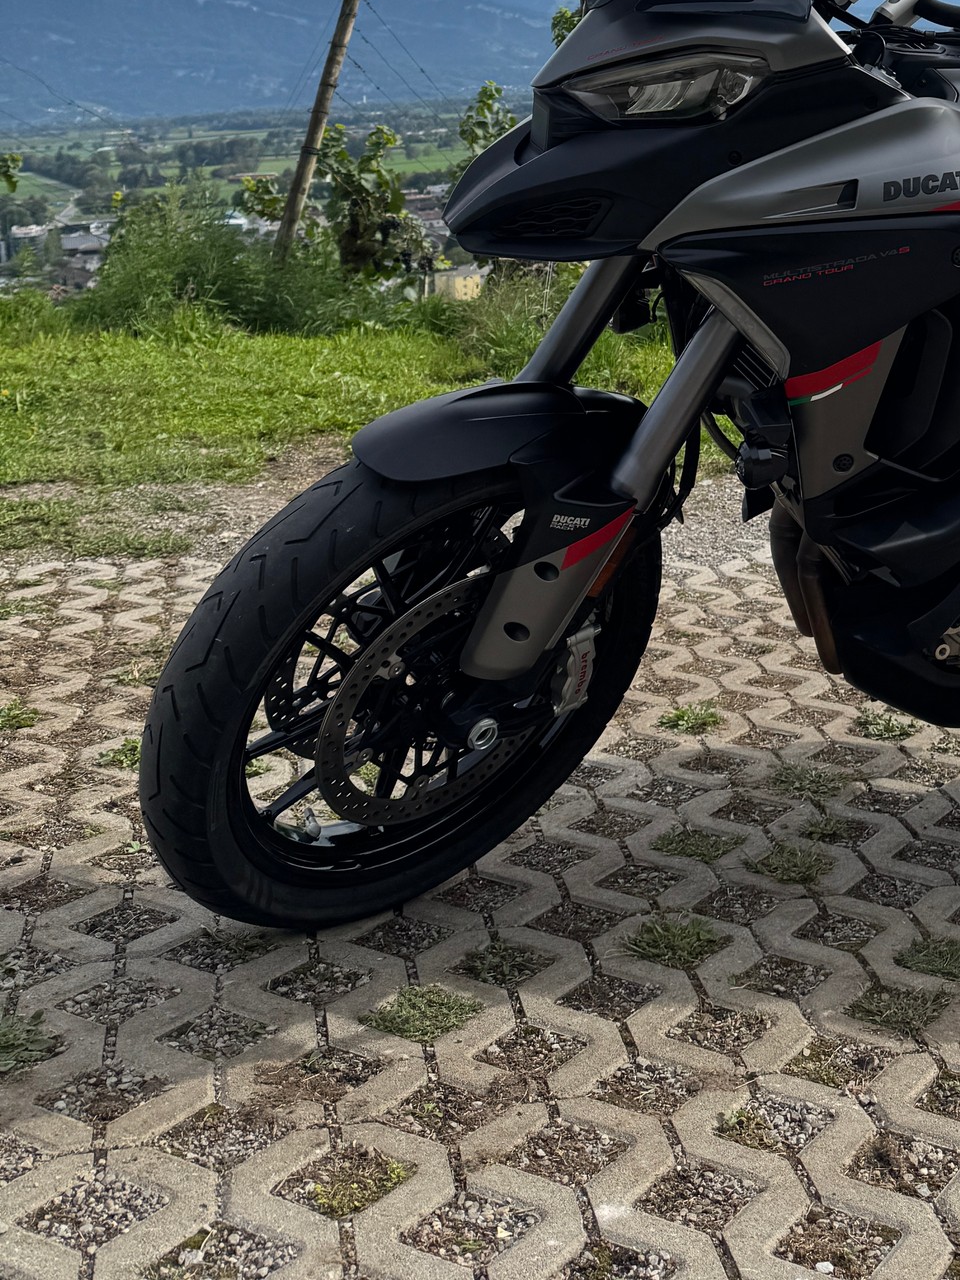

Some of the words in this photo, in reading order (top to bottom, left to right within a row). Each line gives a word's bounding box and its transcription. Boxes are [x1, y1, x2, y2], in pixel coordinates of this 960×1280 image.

[763, 253, 877, 280] MULTISTRADA
[763, 272, 812, 287] GRAND
[816, 263, 854, 277] TOUR
[552, 514, 591, 526] DUCATI
[575, 651, 590, 694] brembo
